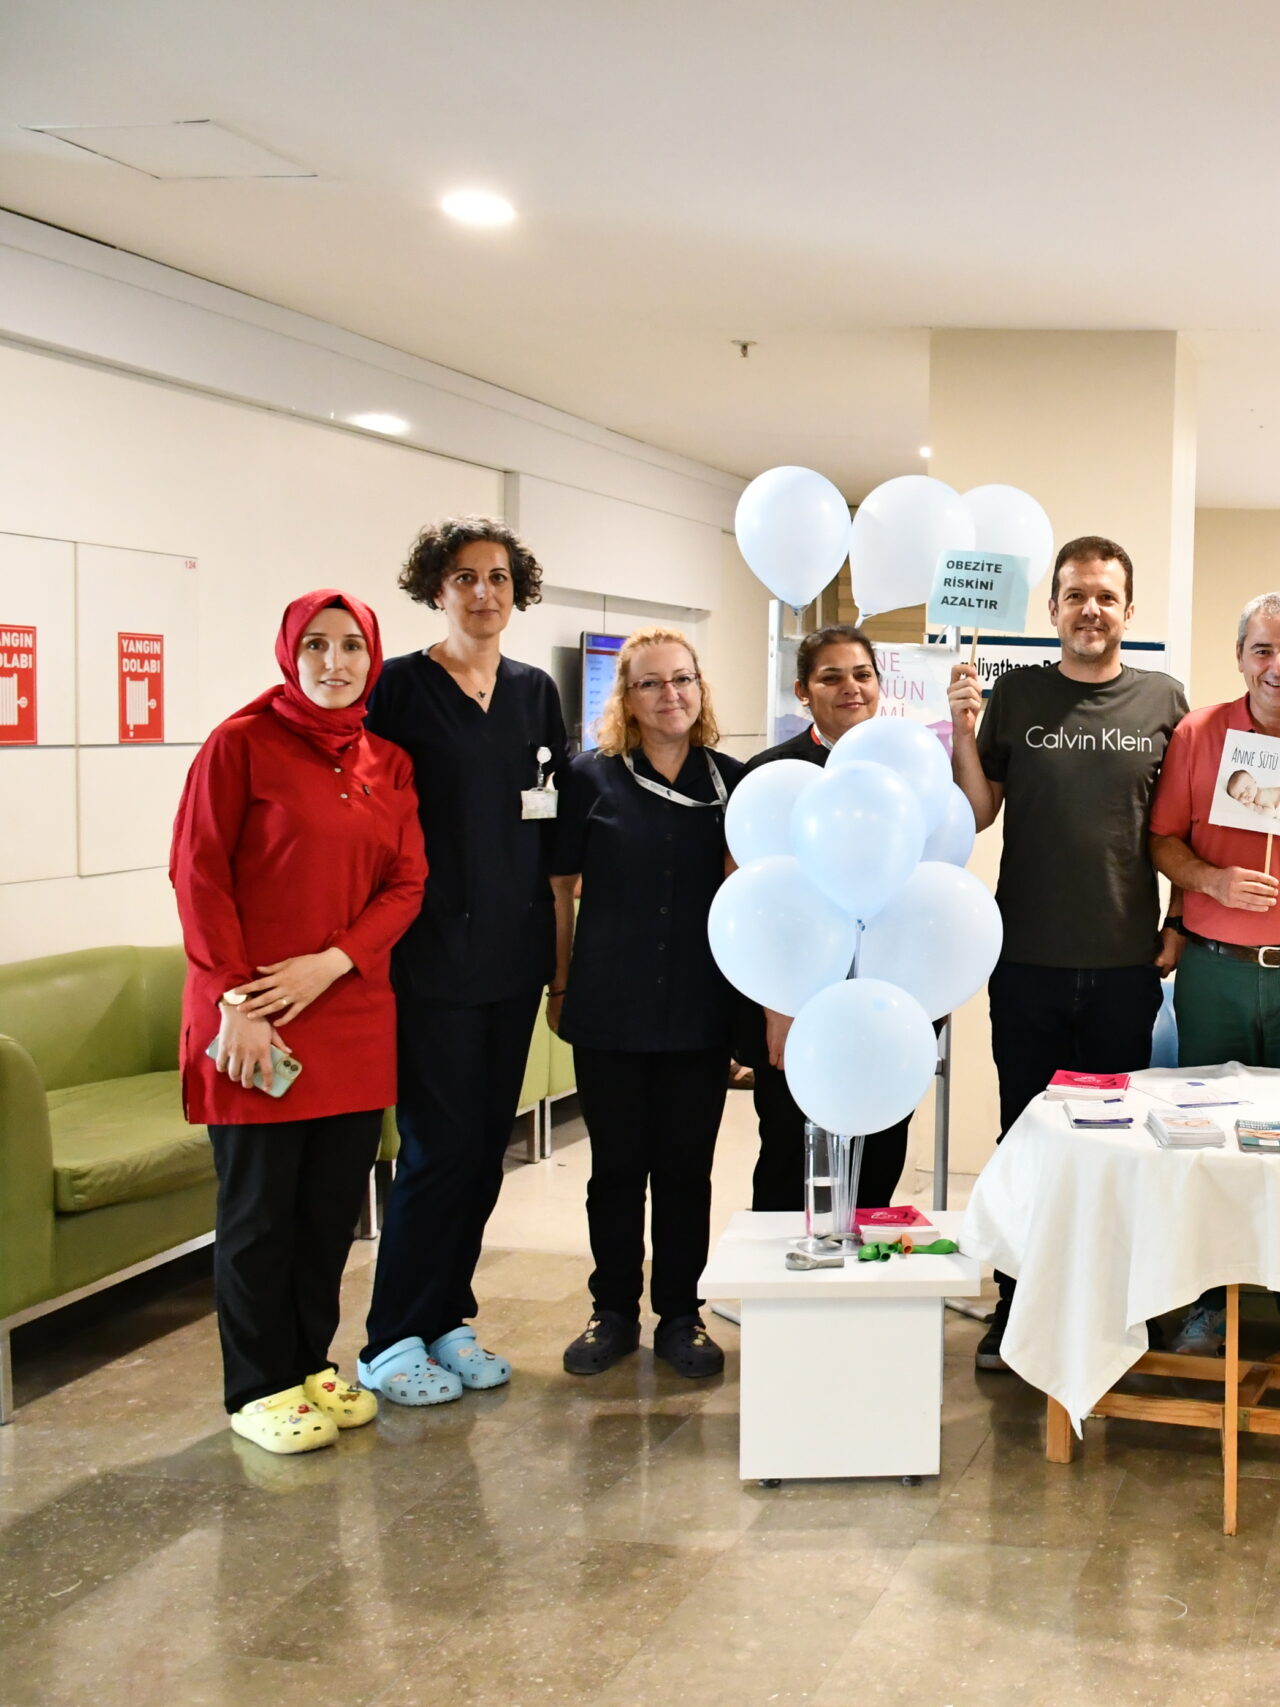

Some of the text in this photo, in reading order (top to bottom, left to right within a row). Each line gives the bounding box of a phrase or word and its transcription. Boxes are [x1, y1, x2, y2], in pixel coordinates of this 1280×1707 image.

[946, 560, 1003, 574] OBEZİTE
[943, 576, 994, 591] RİSKİNİ
[940, 595, 999, 610] AZALTIR
[0, 632, 33, 648] NGIN
[121, 639, 161, 655] YANGIN
[122, 658, 161, 674] DOLABI
[876, 651, 901, 672] NE
[880, 675, 925, 701] NÜN
[1025, 725, 1153, 753] Calvin Klein
[1231, 747, 1256, 767] ANNE
[1257, 750, 1279, 771] SÜTÜ
